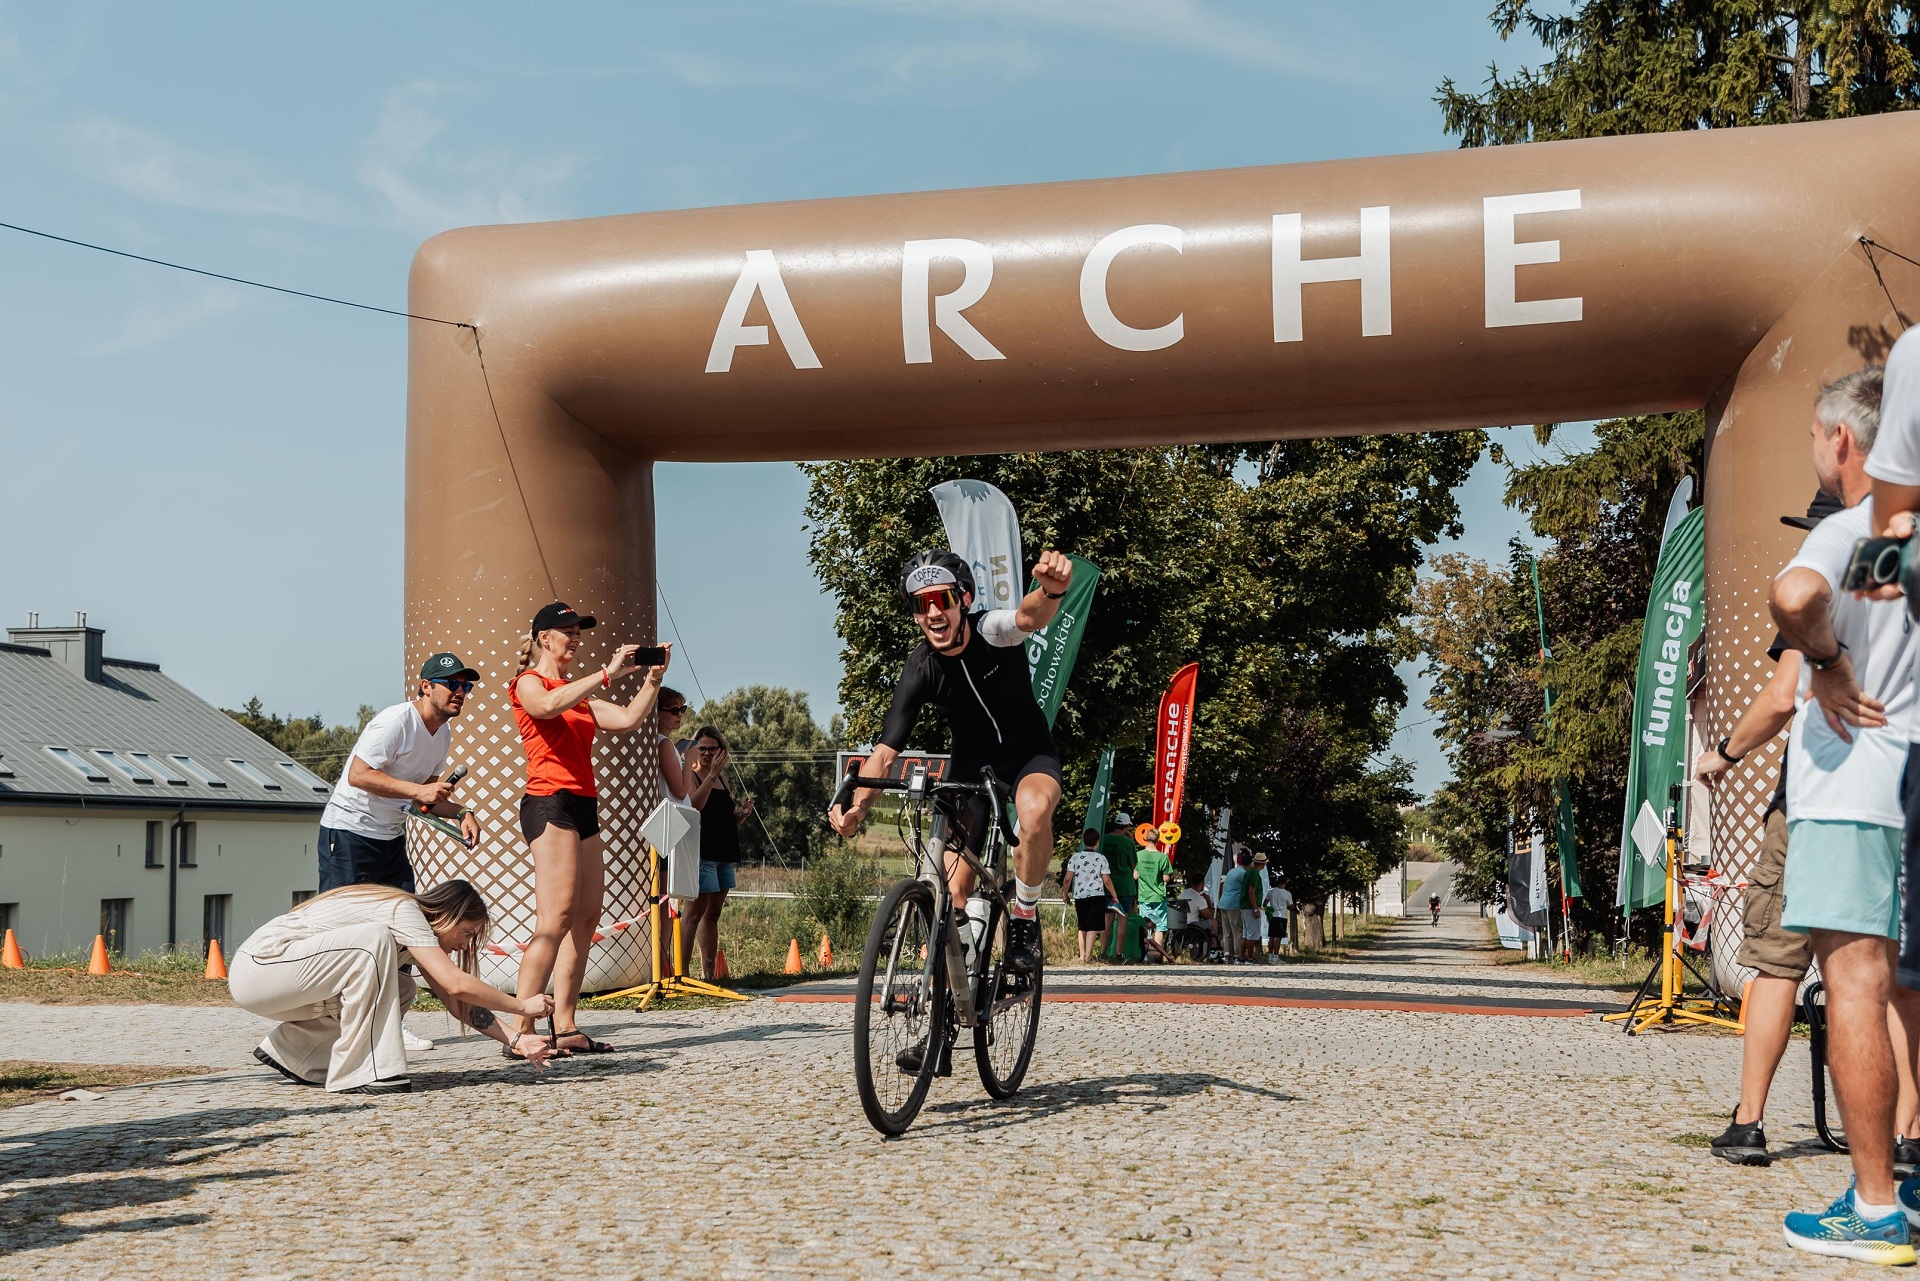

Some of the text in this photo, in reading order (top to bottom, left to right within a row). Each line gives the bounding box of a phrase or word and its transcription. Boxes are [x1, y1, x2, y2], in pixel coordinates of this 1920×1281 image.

[705, 189, 1583, 373] ARCHE
[914, 567, 943, 583] COFFEE
[1643, 580, 1692, 746] fundacja
